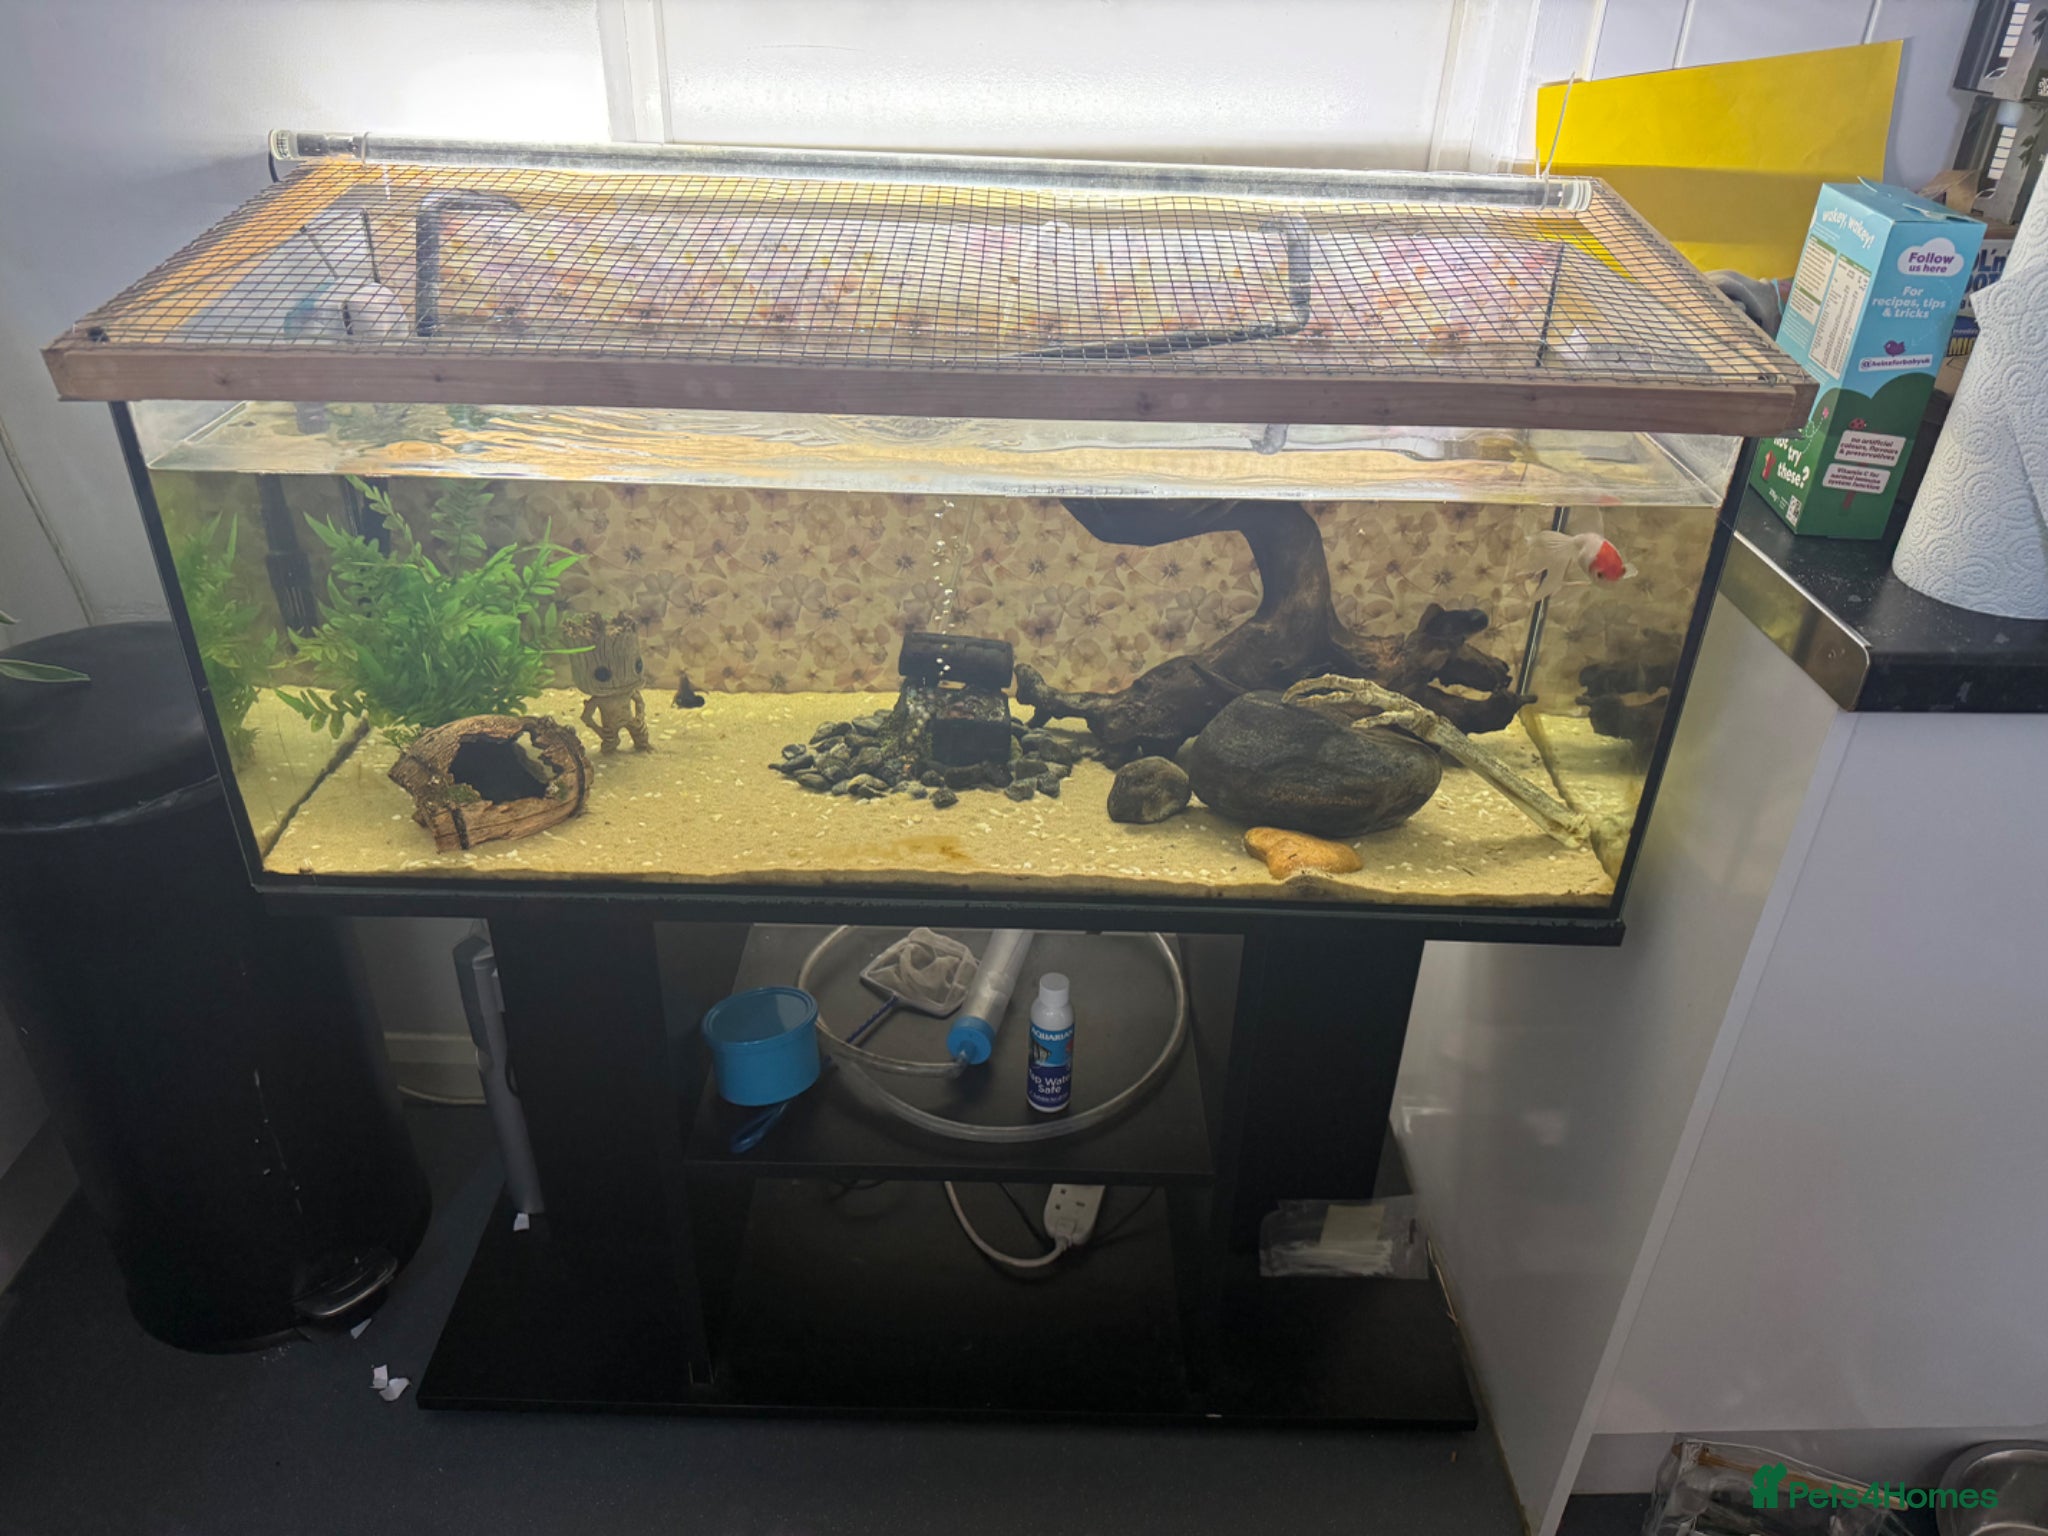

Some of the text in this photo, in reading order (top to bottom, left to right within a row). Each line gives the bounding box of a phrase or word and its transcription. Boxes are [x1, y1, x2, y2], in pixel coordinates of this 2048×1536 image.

[1908, 252, 1954, 264] Follow
[1923, 264, 1947, 273] here
[1902, 286, 1923, 296] For
[1872, 297, 1919, 308] recipes,
[1923, 298, 1946, 310] tips
[1882, 308, 1929, 318] & tricks
[1861, 438, 1894, 447] artificial
[1840, 442, 1898, 455] colours, flavours
[1788, 445, 1802, 468] try
[1845, 450, 1895, 460] preservatives
[1777, 462, 1810, 489] these?
[1038, 1084, 1061, 1094] Safe
